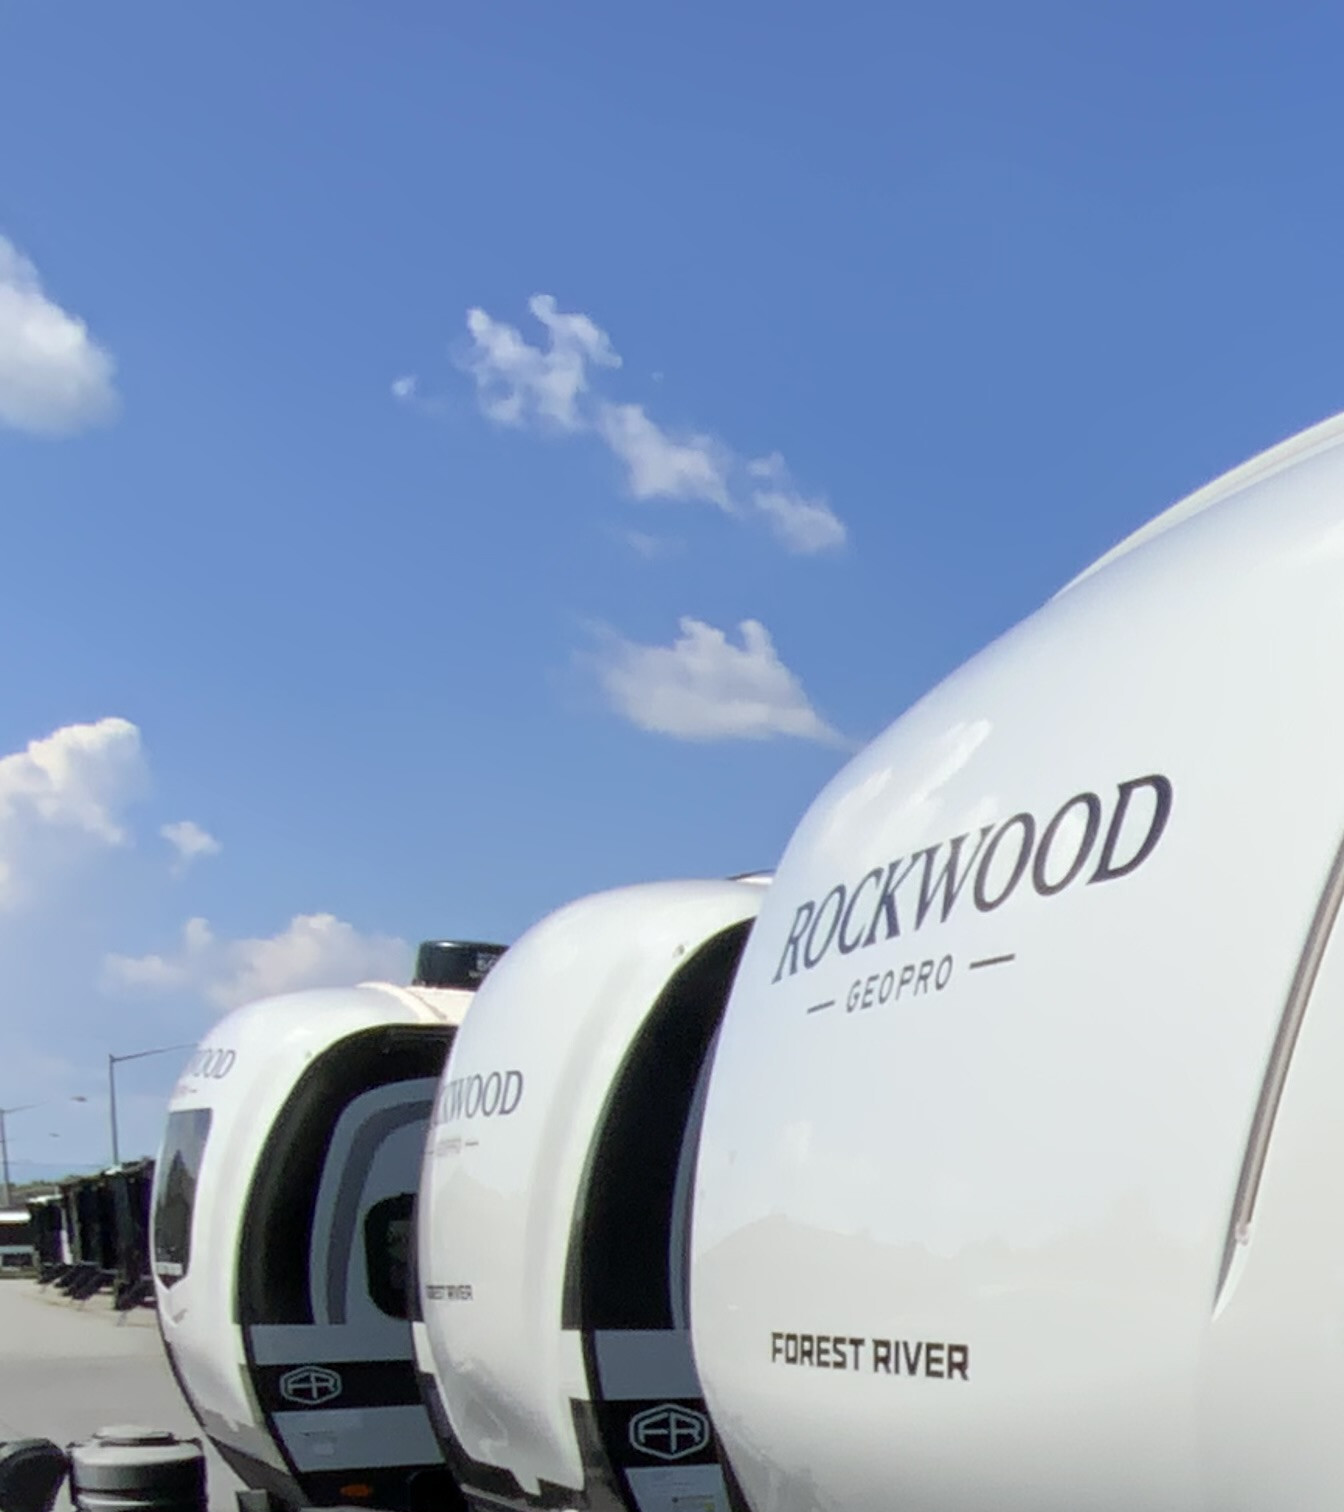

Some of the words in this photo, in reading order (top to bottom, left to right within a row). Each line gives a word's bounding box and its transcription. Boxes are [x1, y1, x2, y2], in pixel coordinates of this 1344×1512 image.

[772, 774, 1173, 985] ROCKWOOD
[845, 953, 954, 1013] GEOPRO
[771, 1332, 865, 1371] FOREST
[872, 1338, 970, 1381] RIVER
